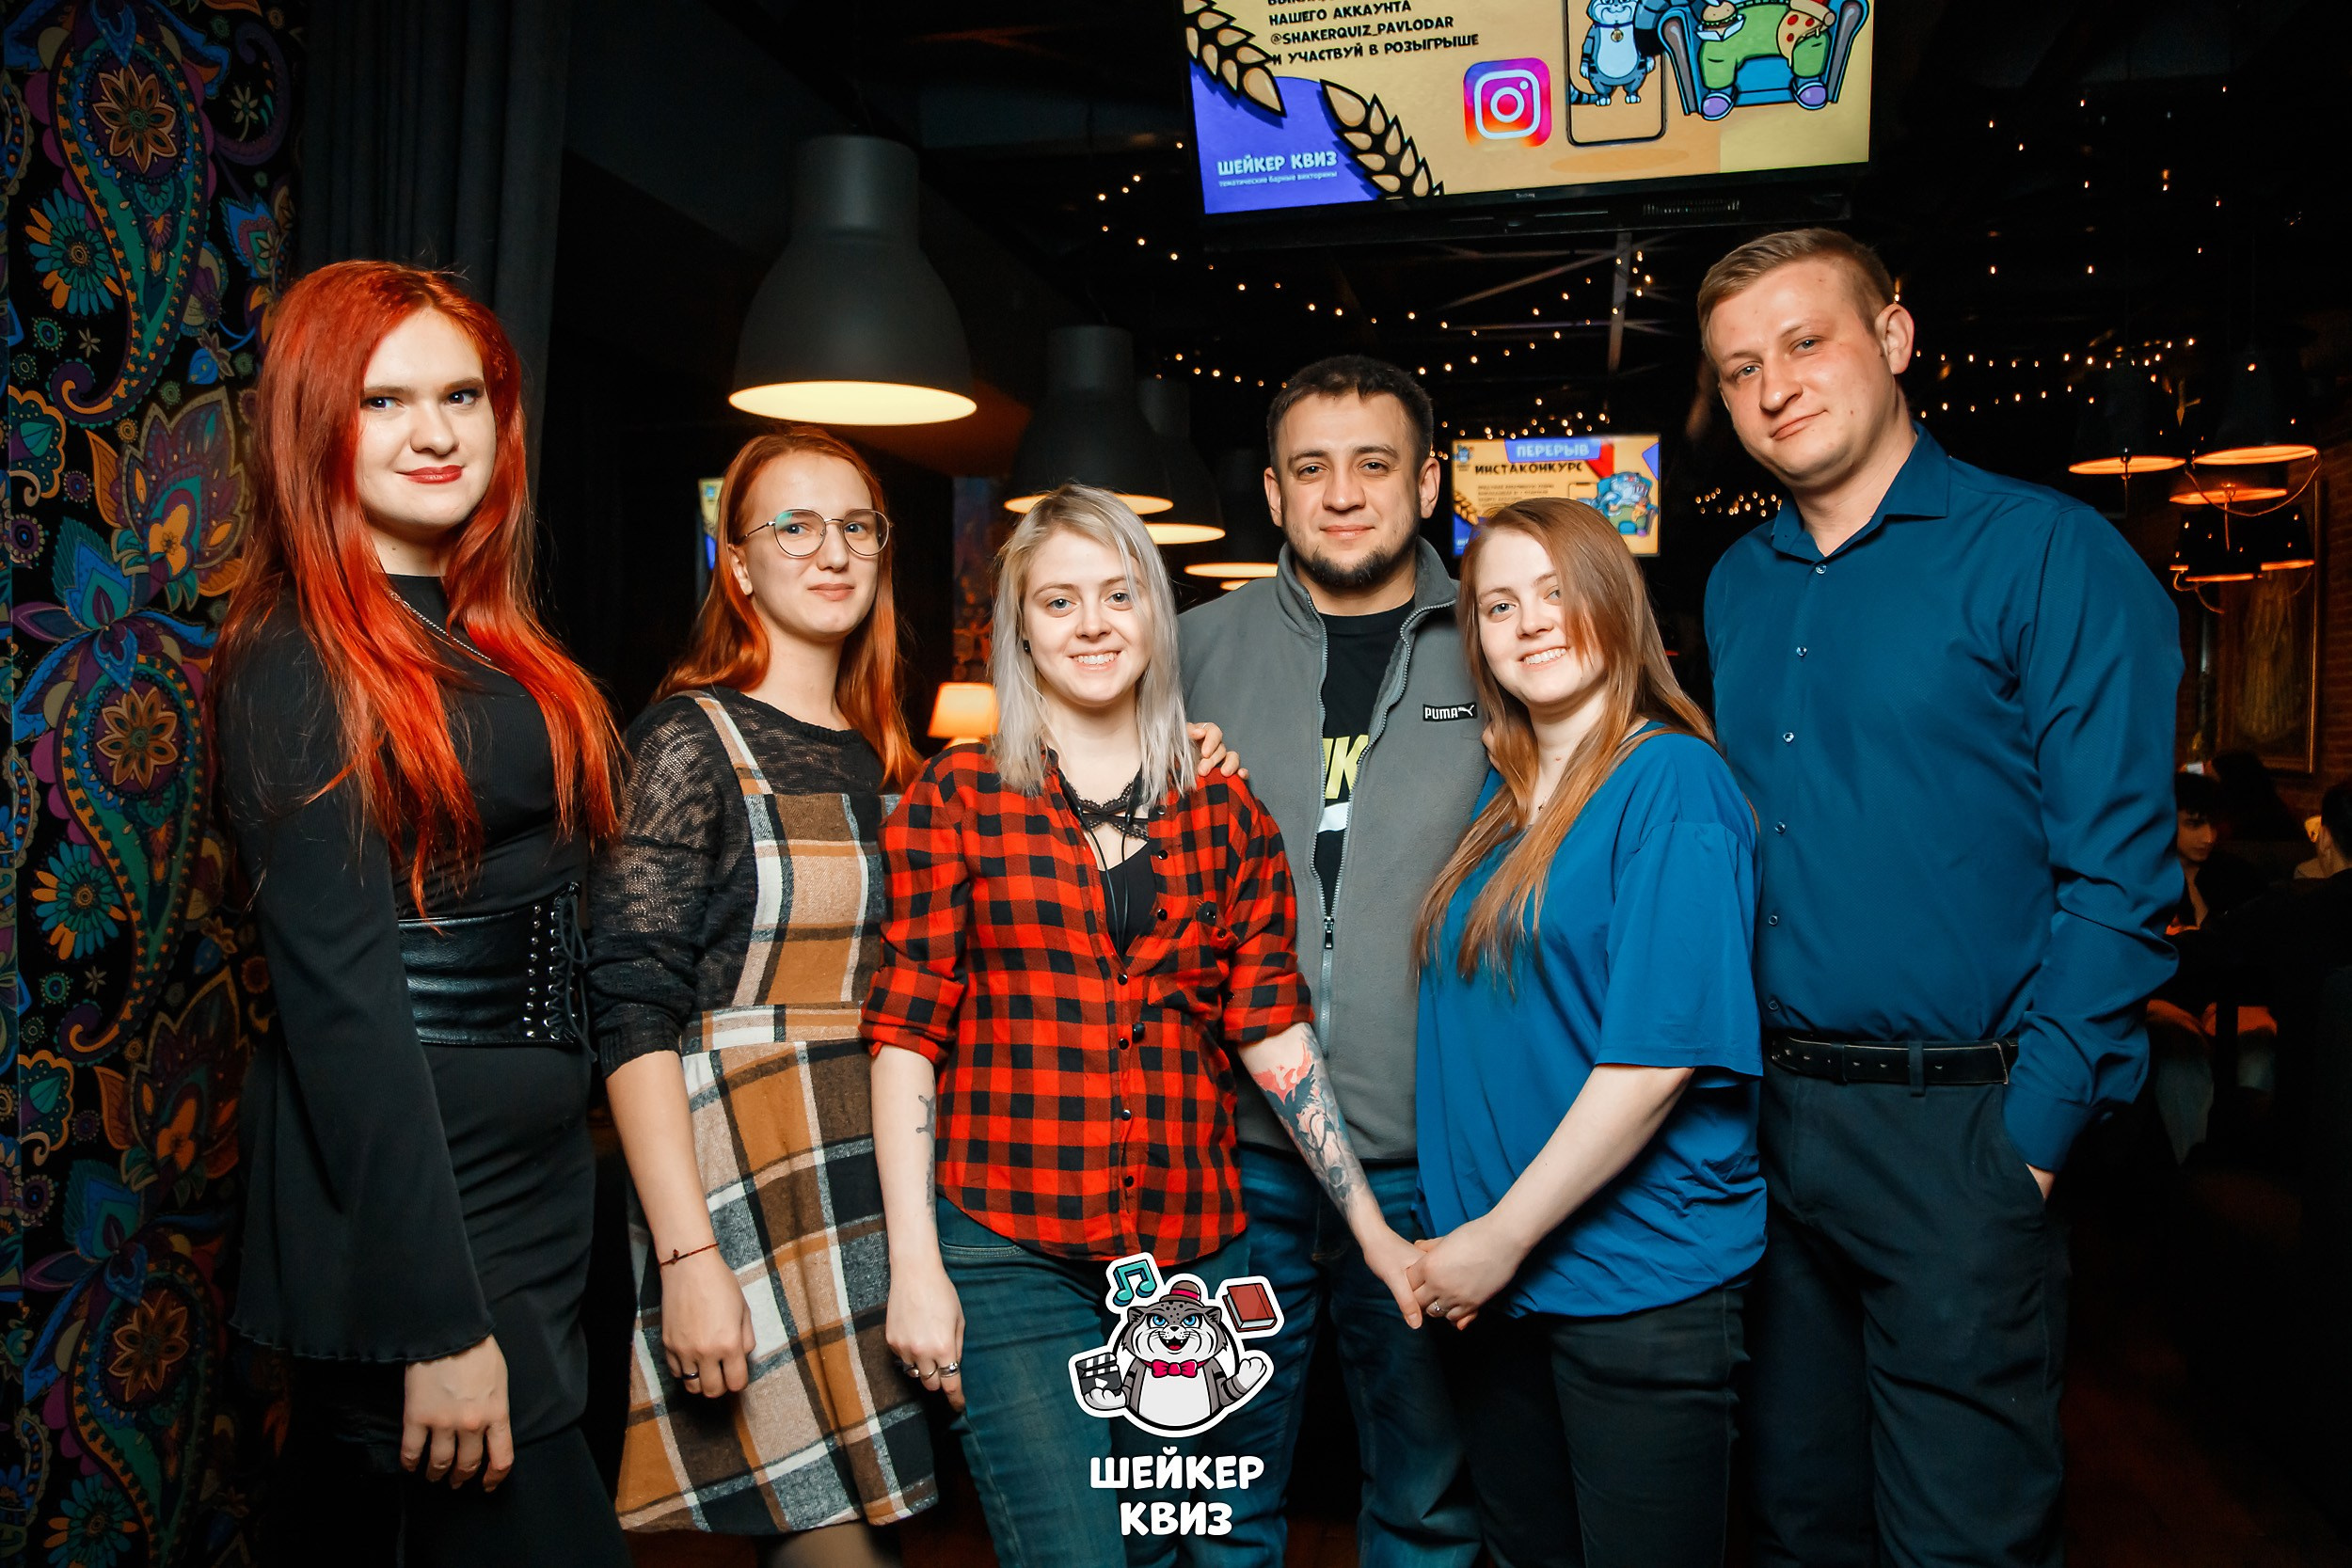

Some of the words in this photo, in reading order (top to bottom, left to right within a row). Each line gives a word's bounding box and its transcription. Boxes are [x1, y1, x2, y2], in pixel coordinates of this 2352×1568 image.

[1269, 8, 1327, 26] НАШЕГО
[1333, 0, 1411, 20] АККАУНТА
[1271, 16, 1454, 45] @SHAKERQUIZ_PAVLODAR
[1288, 42, 1363, 64] УЧАСТВУЙ
[1369, 44, 1379, 56] В
[1385, 34, 1479, 55] РОЗЫГРЫШЕ
[1217, 154, 1286, 176] ШЕЙКЕР
[1290, 150, 1338, 169] КВИЗ
[1517, 444, 1590, 457] ПЕРЕРЫВ
[1475, 463, 1582, 475] ИНСТАКОНКУРС
[1424, 706, 1458, 720] PUMA
